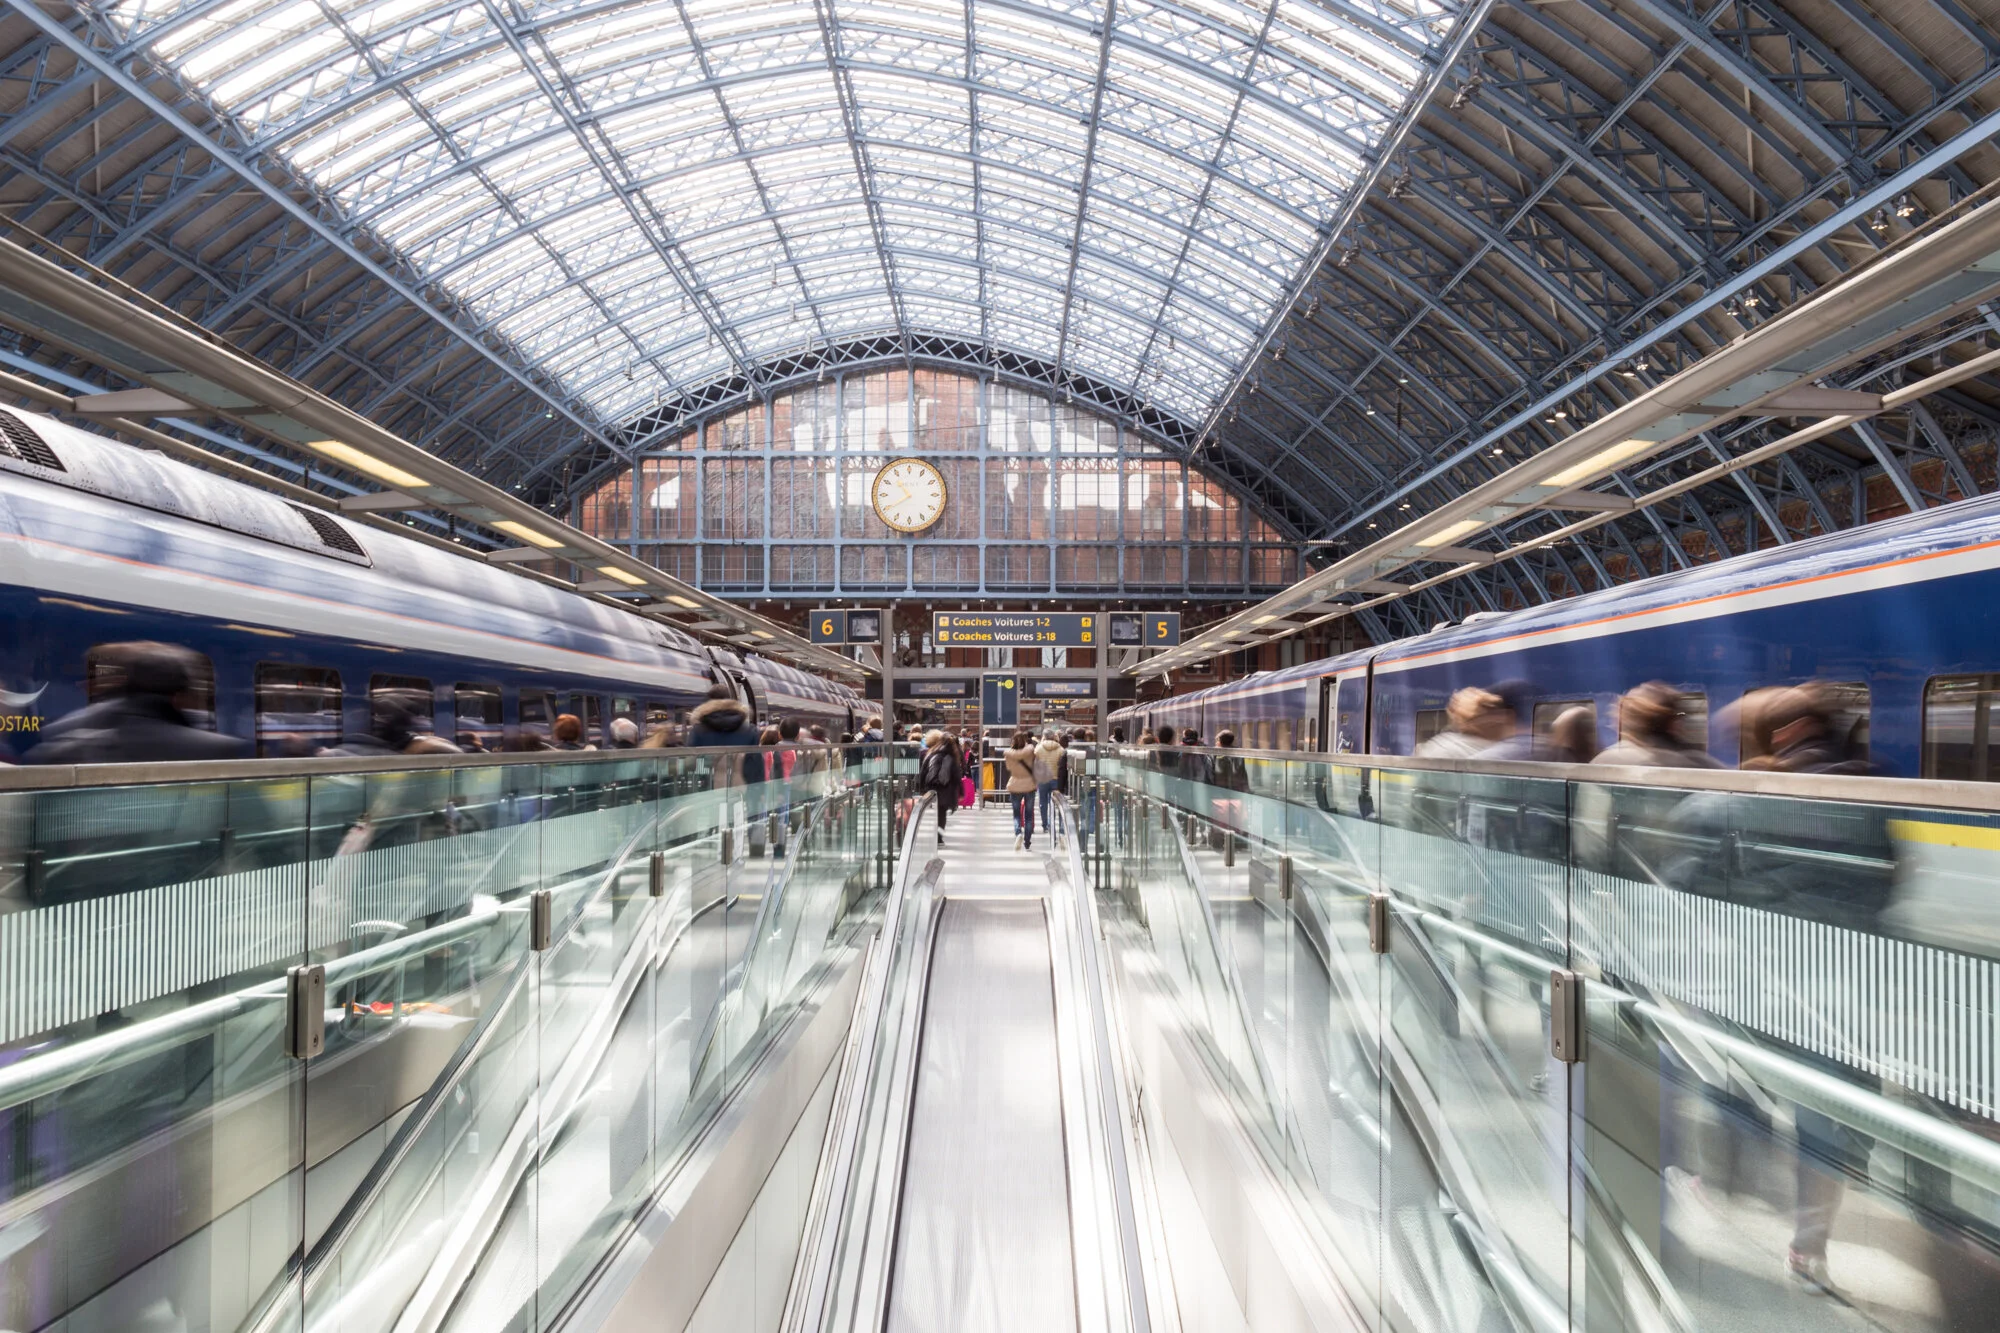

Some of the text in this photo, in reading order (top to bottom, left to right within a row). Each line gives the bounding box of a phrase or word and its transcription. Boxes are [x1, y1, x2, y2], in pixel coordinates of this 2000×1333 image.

[821, 618, 834, 636] 6
[952, 617, 1050, 627] Coaches Voitures 1-2
[952, 632, 1056, 641] Coaches Voitures 3-18
[1157, 621, 1168, 639] 5
